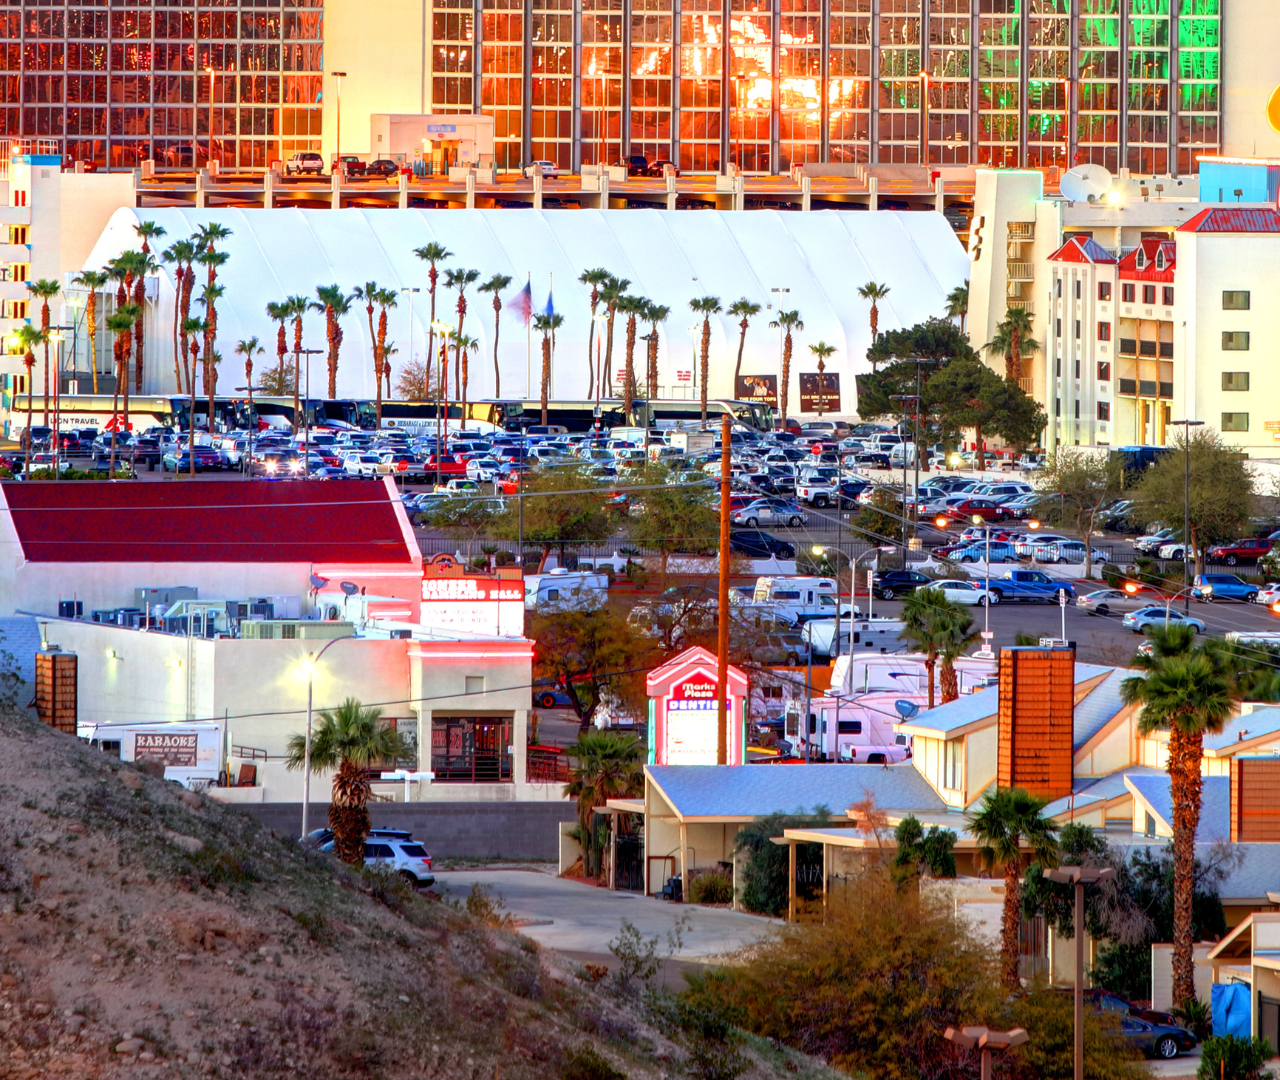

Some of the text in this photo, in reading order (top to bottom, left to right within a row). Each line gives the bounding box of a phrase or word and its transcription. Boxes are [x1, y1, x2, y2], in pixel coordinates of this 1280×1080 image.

[70, 417, 100, 425] TRAVEL
[421, 579, 477, 591] IONEER
[489, 590, 522, 600] HALL
[682, 683, 716, 691] Marks
[684, 690, 714, 698] Plaza
[669, 700, 729, 710] DENTIS
[136, 735, 196, 747] KARAOKE
[450, 735, 462, 748] 24
